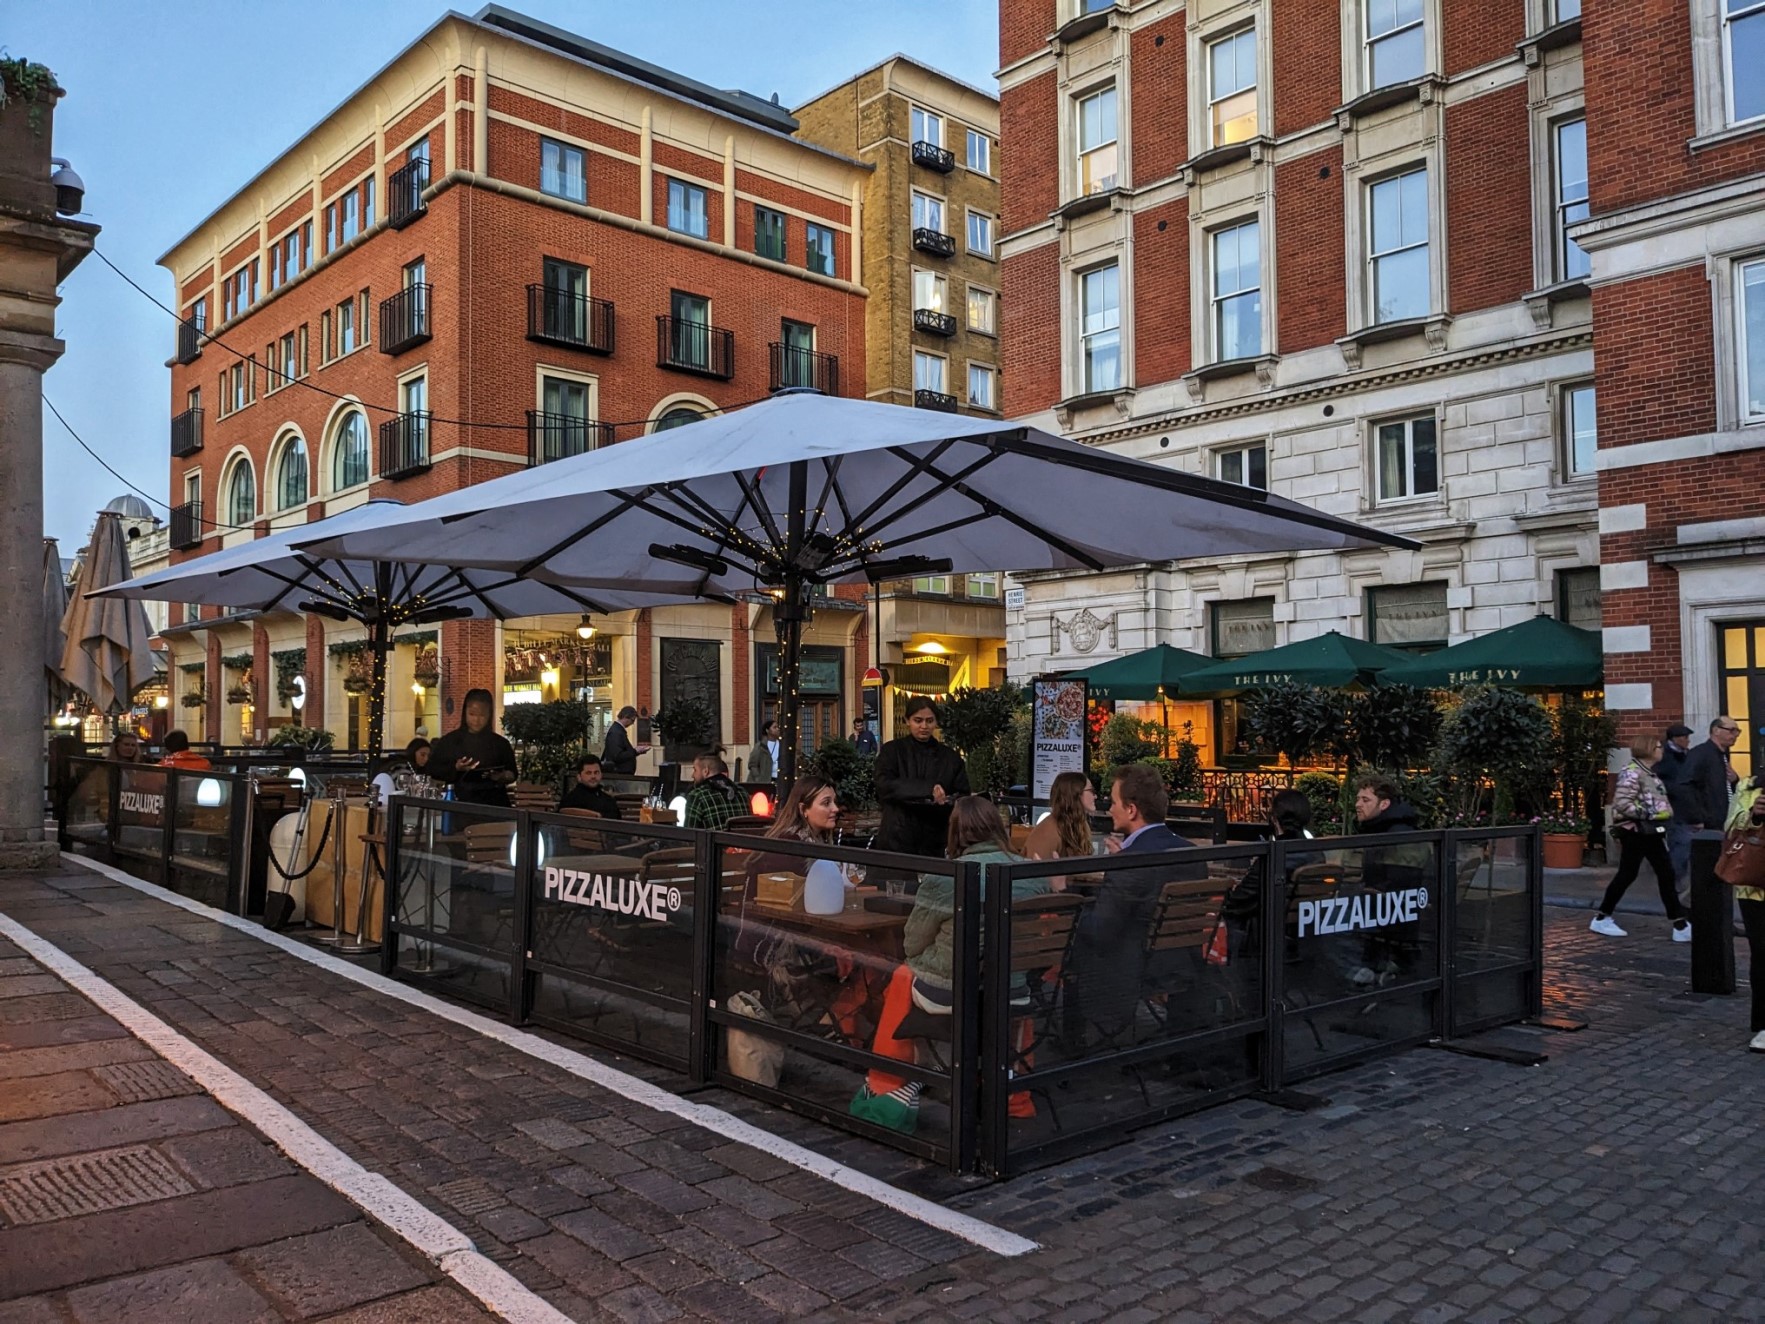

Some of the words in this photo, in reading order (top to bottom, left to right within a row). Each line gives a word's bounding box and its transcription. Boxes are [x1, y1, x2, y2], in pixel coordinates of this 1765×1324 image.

[1234, 675, 1260, 685] THE
[1265, 674, 1292, 684] IVY
[1448, 670, 1480, 684] THE
[1487, 669, 1520, 680] IVY
[1089, 688, 1110, 697] IVY
